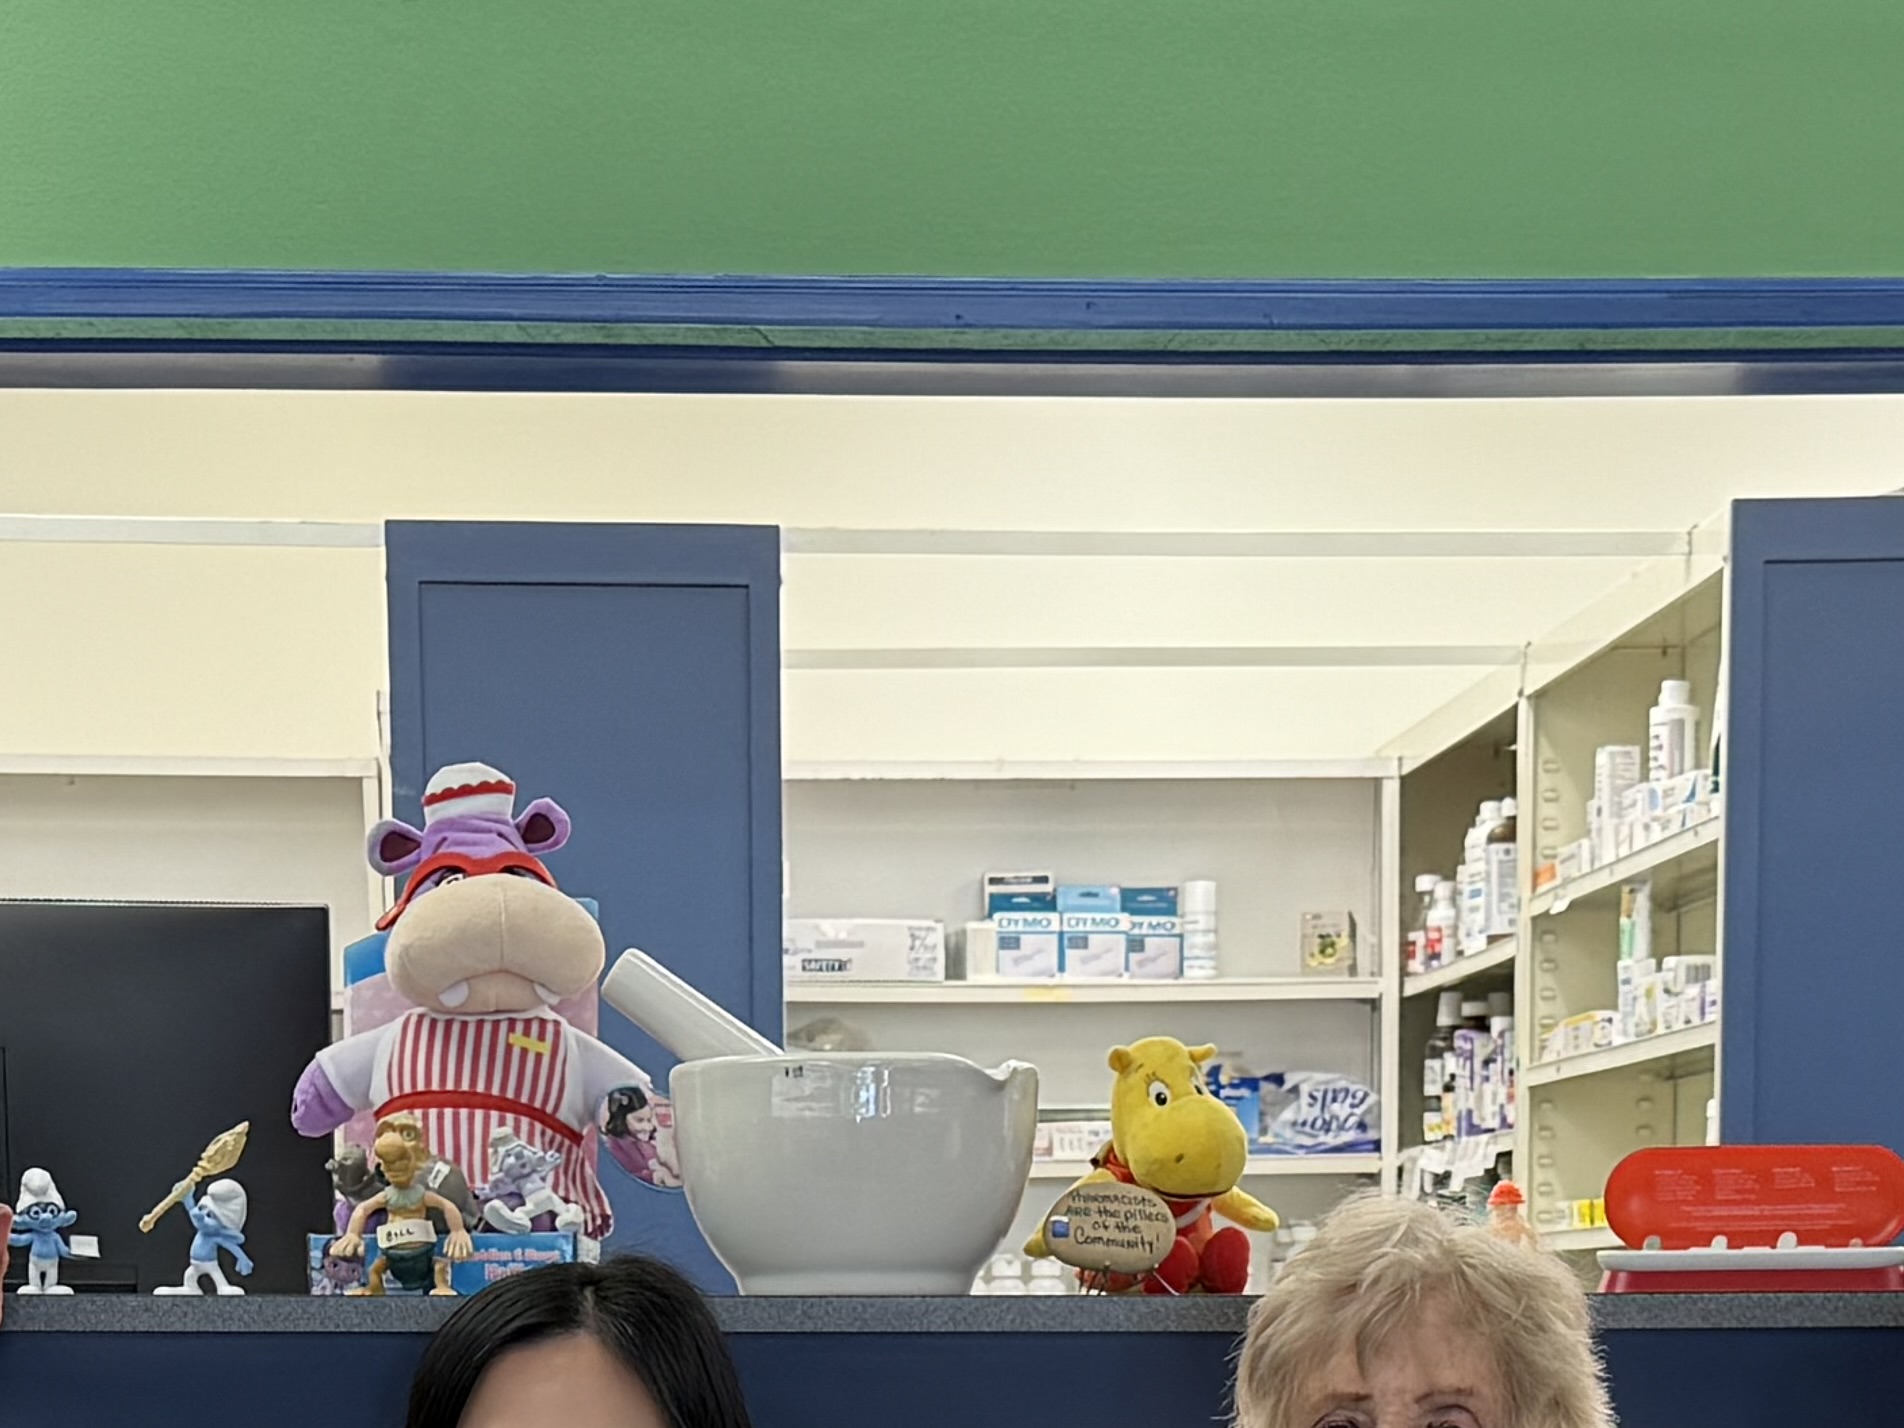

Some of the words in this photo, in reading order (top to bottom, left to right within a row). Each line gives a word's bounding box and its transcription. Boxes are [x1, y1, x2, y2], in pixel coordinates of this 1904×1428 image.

[998, 917, 1052, 930] DYMO
[1067, 917, 1119, 930] DYMO
[1095, 1206, 1120, 1218] the
[1115, 1222, 1141, 1233] the
